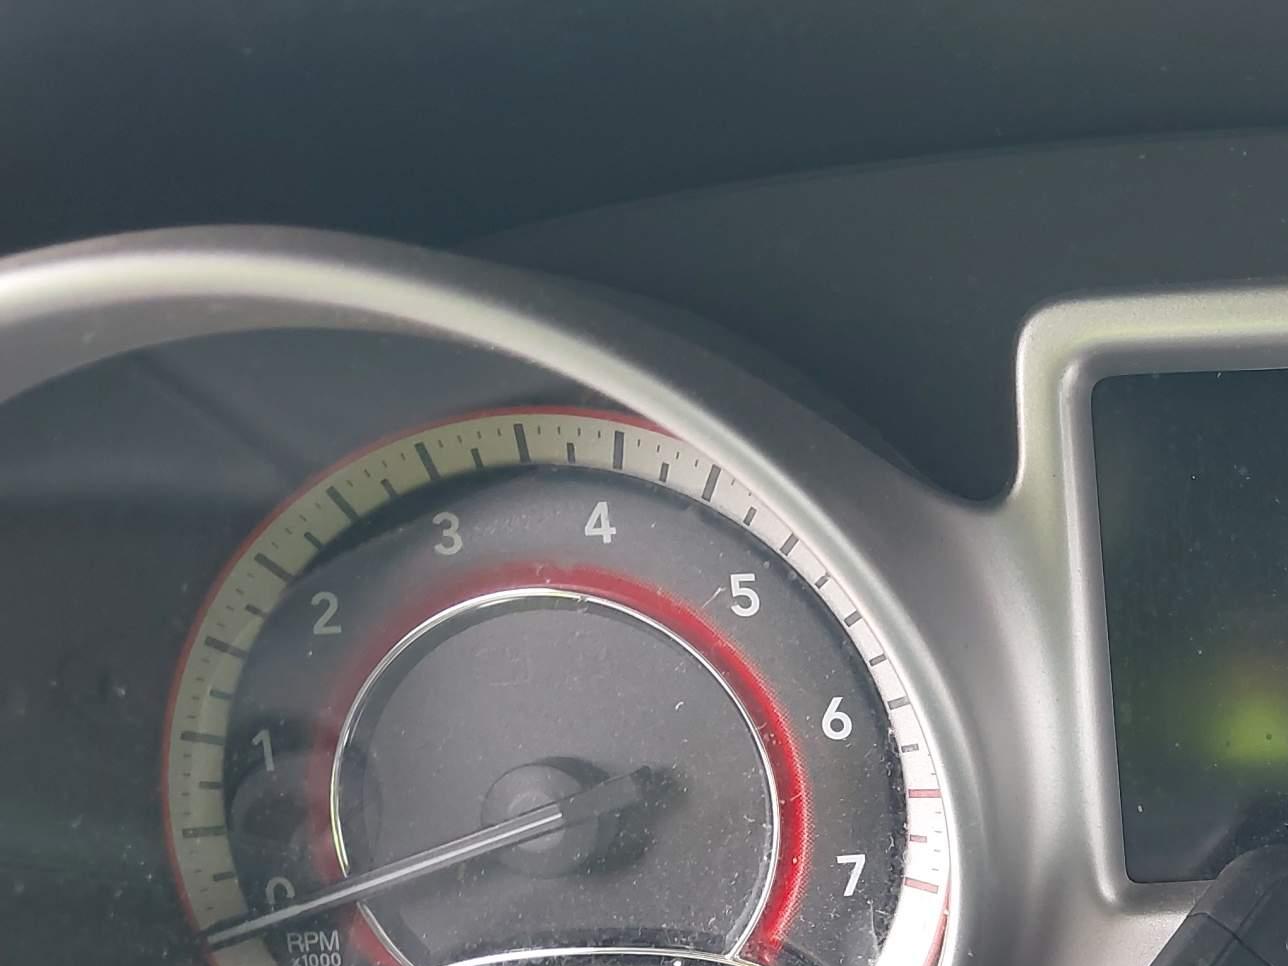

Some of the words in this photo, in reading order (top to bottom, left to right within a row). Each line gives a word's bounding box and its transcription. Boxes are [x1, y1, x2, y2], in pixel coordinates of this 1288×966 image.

[432, 511, 463, 556] 3
[584, 501, 616, 544] 4
[311, 592, 342, 636] 2
[729, 573, 760, 617] 5
[821, 697, 853, 740] 6
[251, 729, 276, 772] 1
[836, 854, 867, 898] 7
[286, 929, 341, 953] RPM
